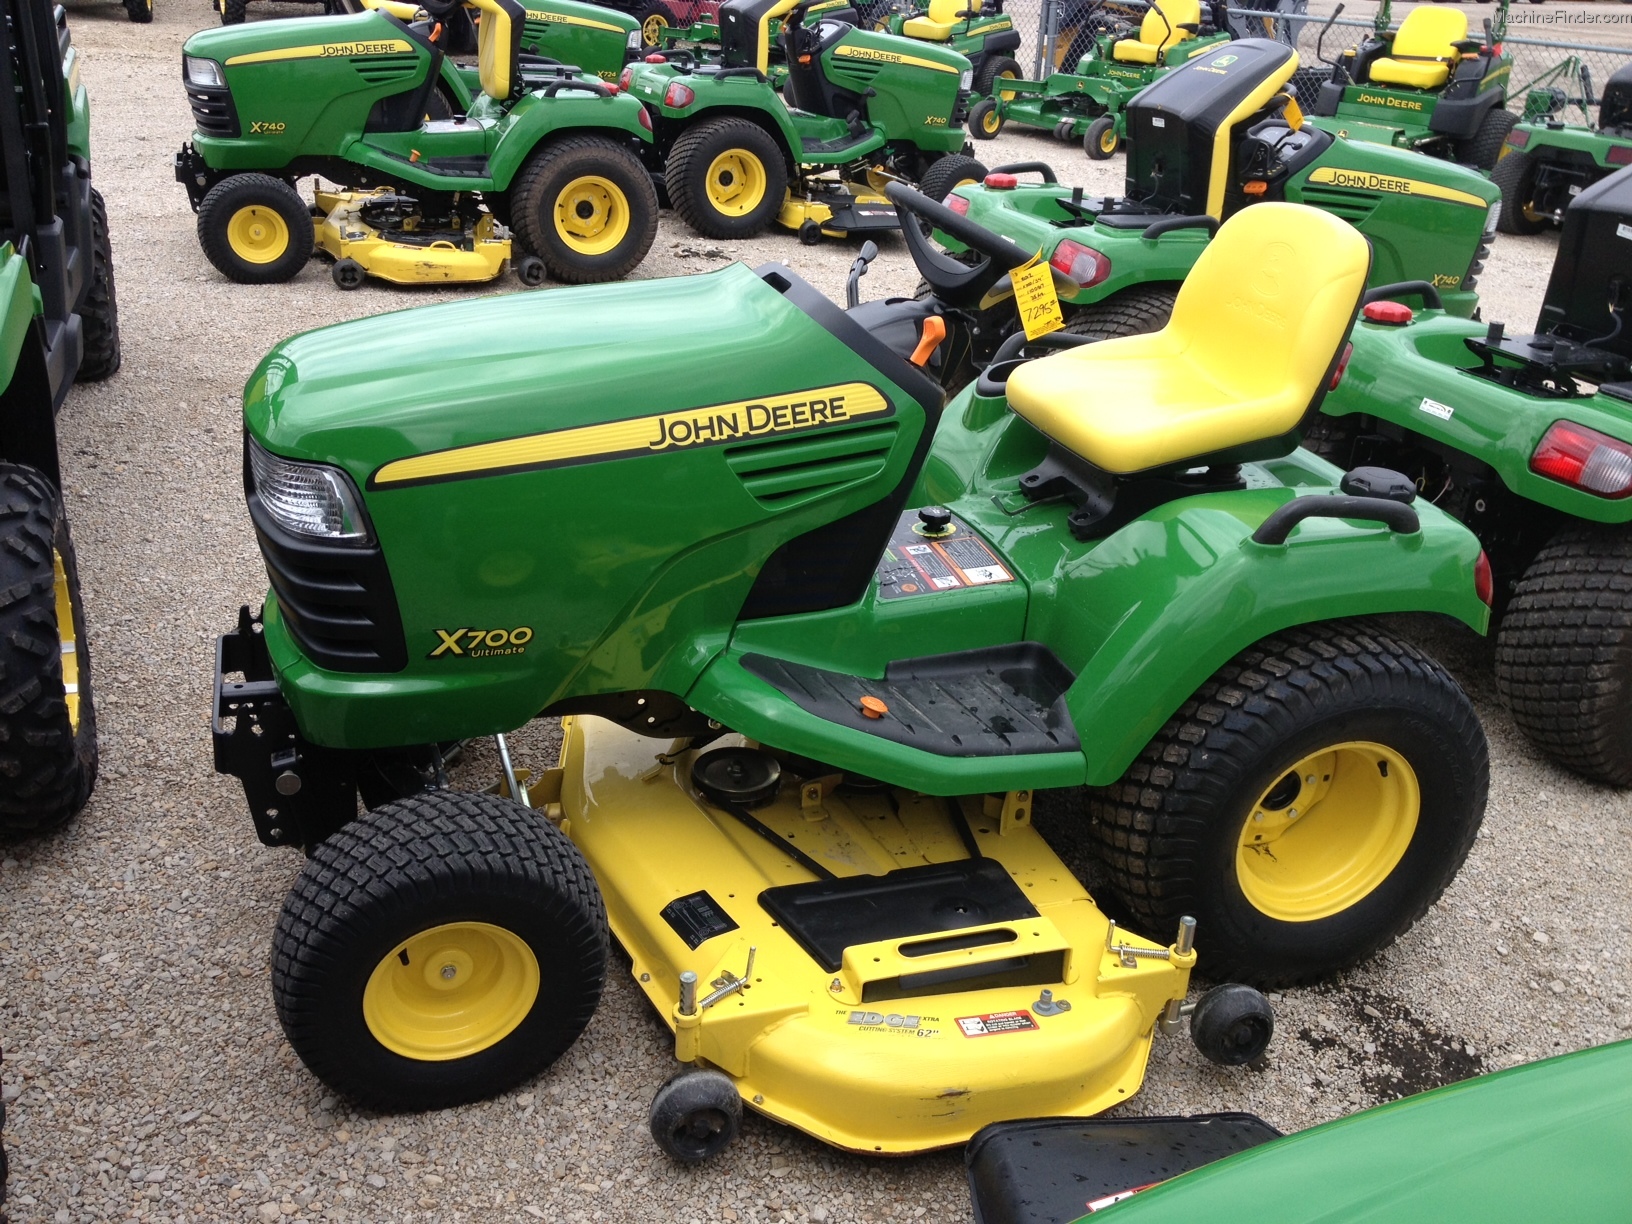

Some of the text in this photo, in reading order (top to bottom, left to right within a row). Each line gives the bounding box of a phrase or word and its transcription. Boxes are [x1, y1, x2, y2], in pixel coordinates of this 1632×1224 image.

[526, 12, 568, 23] HN DEERE
[320, 43, 396, 56] JOHN DEERE
[847, 48, 902, 63] JOHN DEERE
[1357, 93, 1423, 110] JOHN DEERE
[250, 121, 286, 133] X740
[924, 115, 947, 125] X740
[1328, 171, 1411, 193] JOHN DEERE
[1430, 273, 1460, 287] X740
[1023, 302, 1053, 322] 7295
[650, 396, 848, 448] JOHN DEERE
[430, 626, 533, 656] X700
[471, 647, 525, 658] Ultimate
[847, 1011, 921, 1029] EDGE
[916, 1028, 939, 1038] 62"
